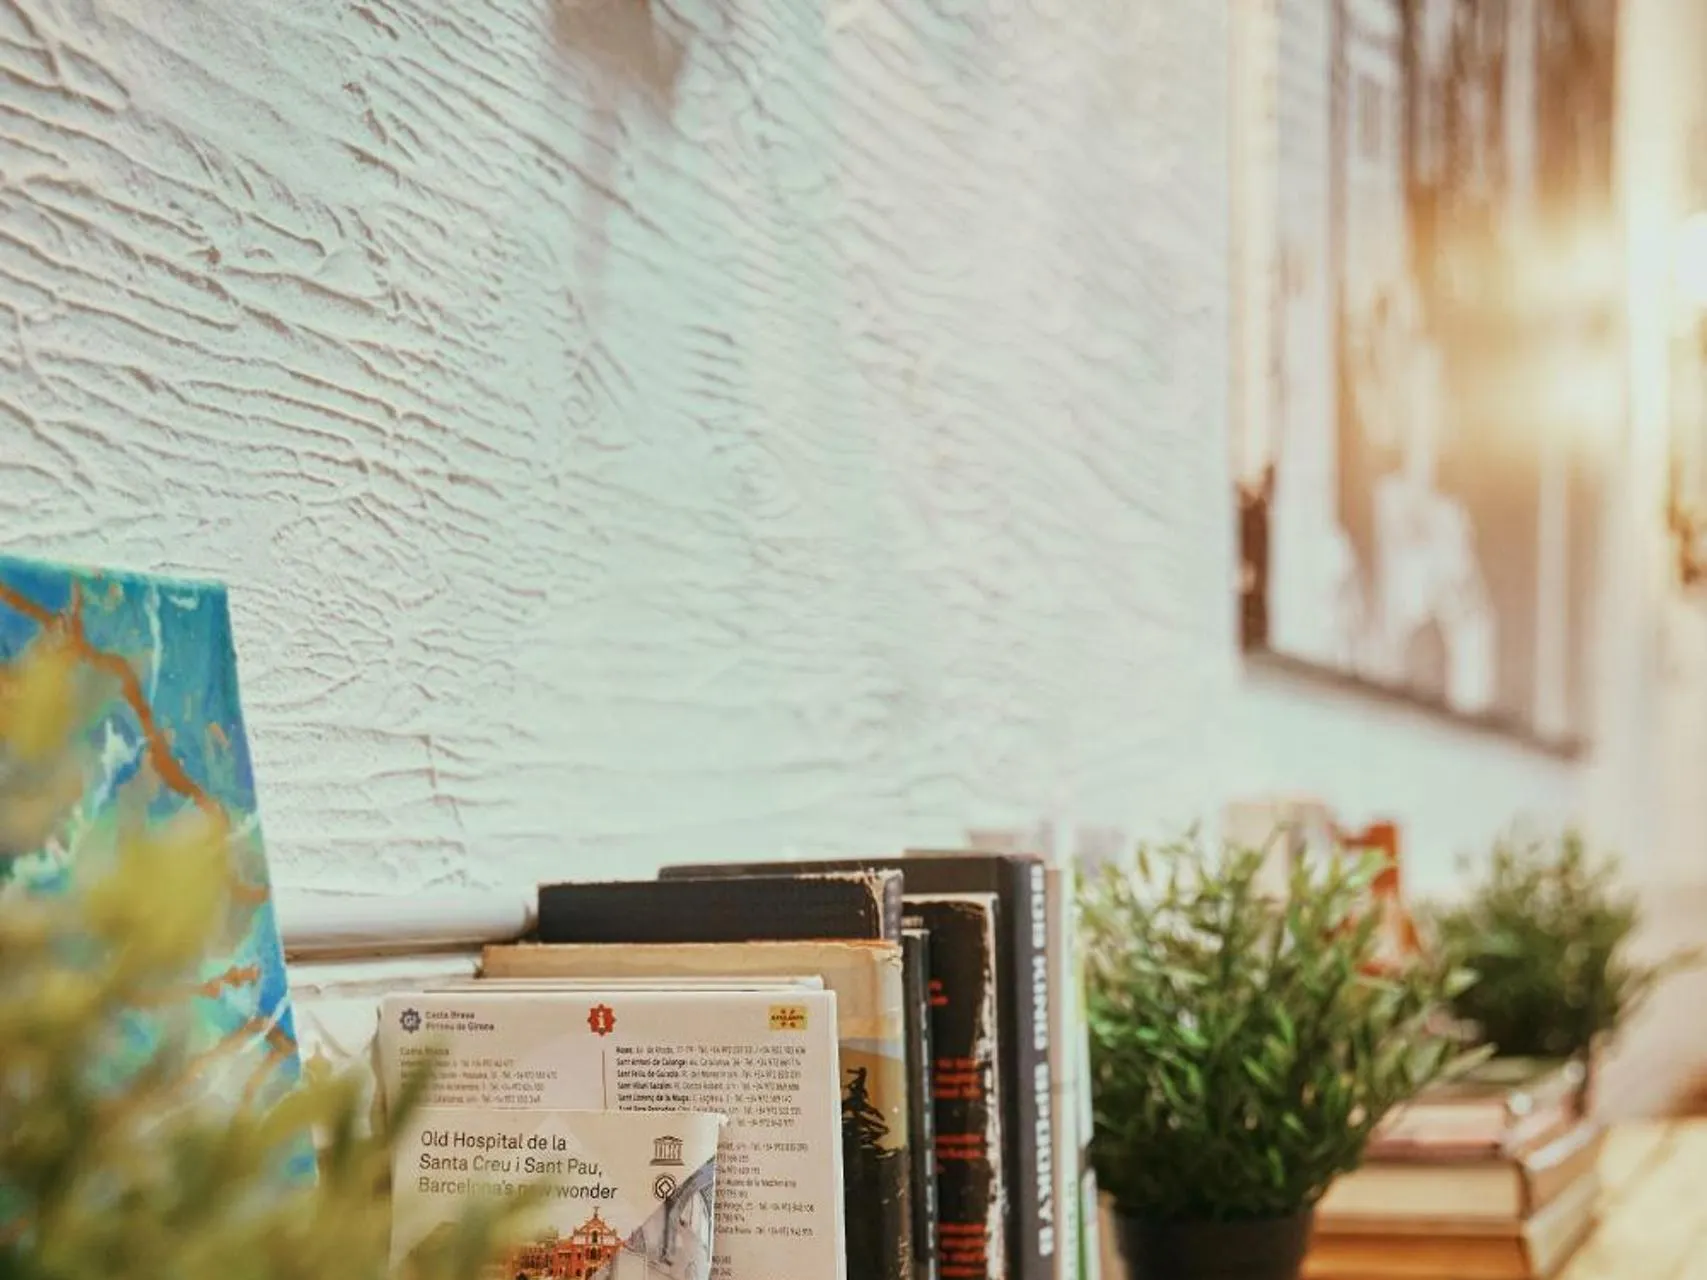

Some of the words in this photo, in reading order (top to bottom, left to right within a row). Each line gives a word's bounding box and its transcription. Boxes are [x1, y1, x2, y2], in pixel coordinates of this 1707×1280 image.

[425, 1011, 448, 1019] Costa
[450, 1010, 475, 1019] Brava
[467, 1022, 494, 1031] Girona
[420, 1130, 449, 1147] Old
[453, 1132, 523, 1152] Hospital
[527, 1133, 548, 1150] de
[552, 1135, 567, 1151] la
[419, 1153, 468, 1172] Santa
[472, 1154, 511, 1173] Creu
[515, 1156, 520, 1173] i
[524, 1156, 563, 1174] Sant
[567, 1158, 602, 1177] Pau,
[517, 1182, 552, 1199] nw
[555, 1182, 619, 1200] wonder
